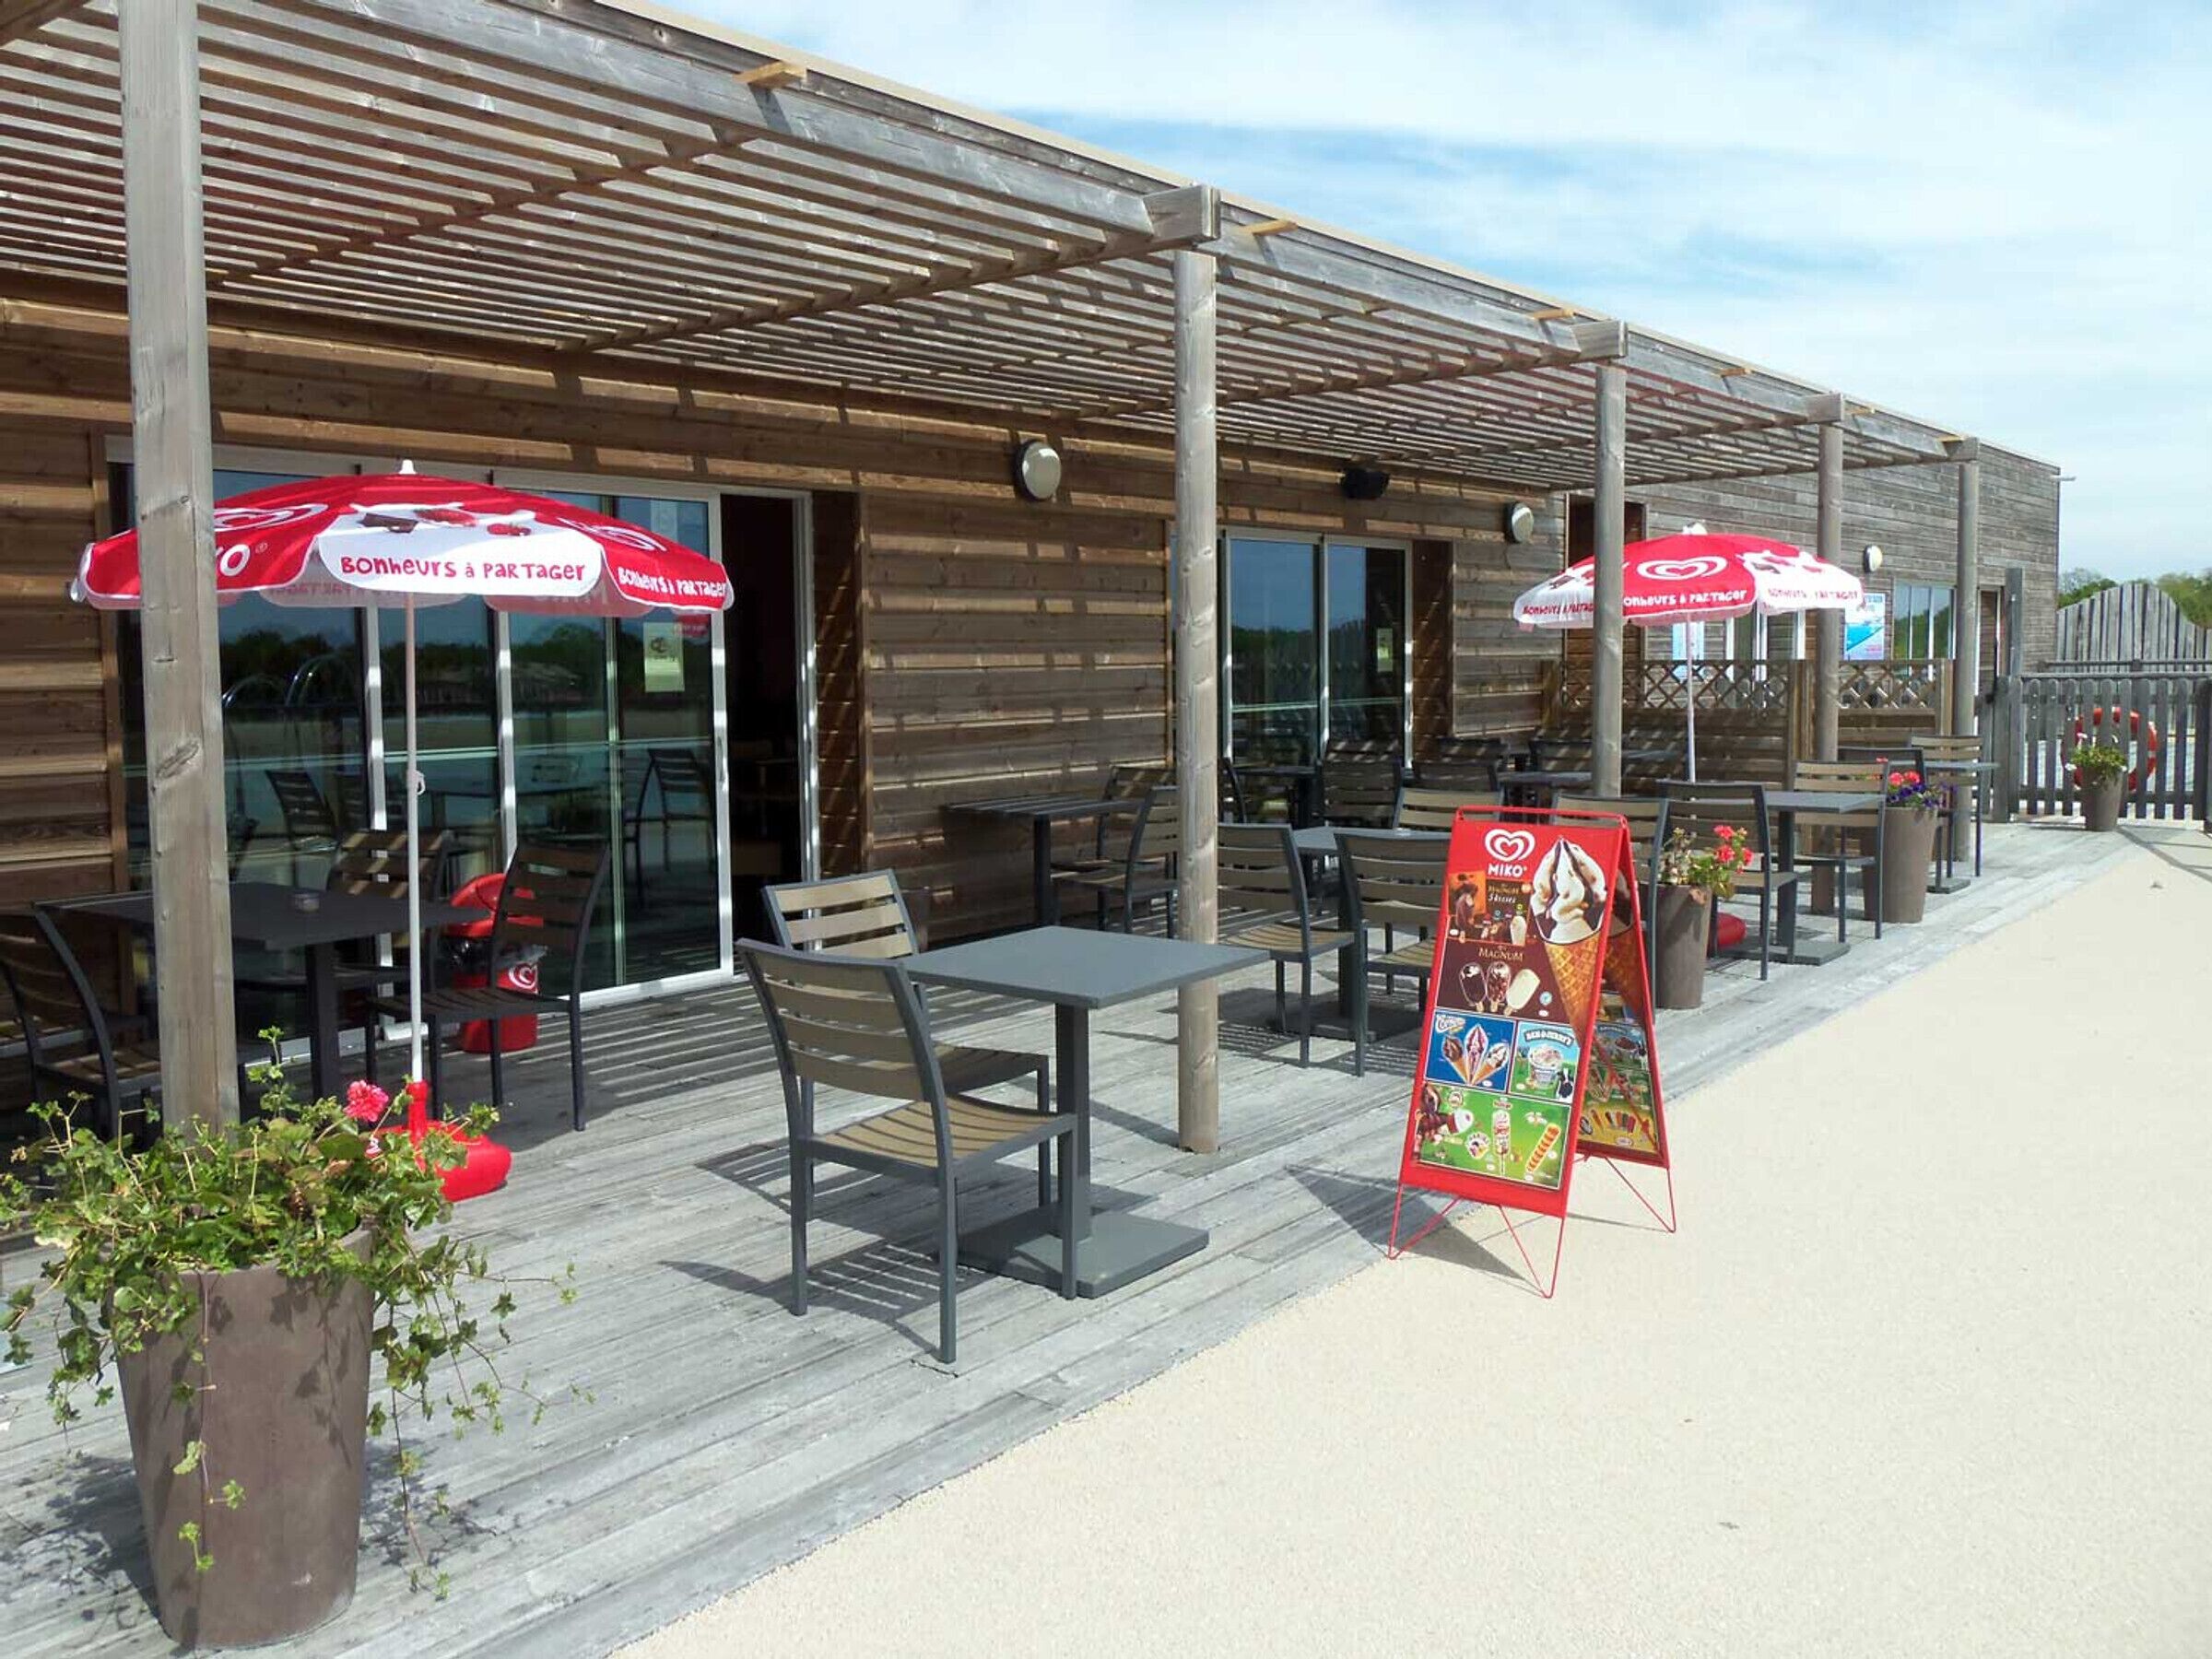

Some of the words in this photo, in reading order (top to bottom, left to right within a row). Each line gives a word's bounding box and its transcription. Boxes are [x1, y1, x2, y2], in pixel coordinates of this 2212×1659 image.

[465, 562, 475, 578] à
[1623, 594, 1677, 606] onheurs
[1488, 863, 1524, 877] MIKO
